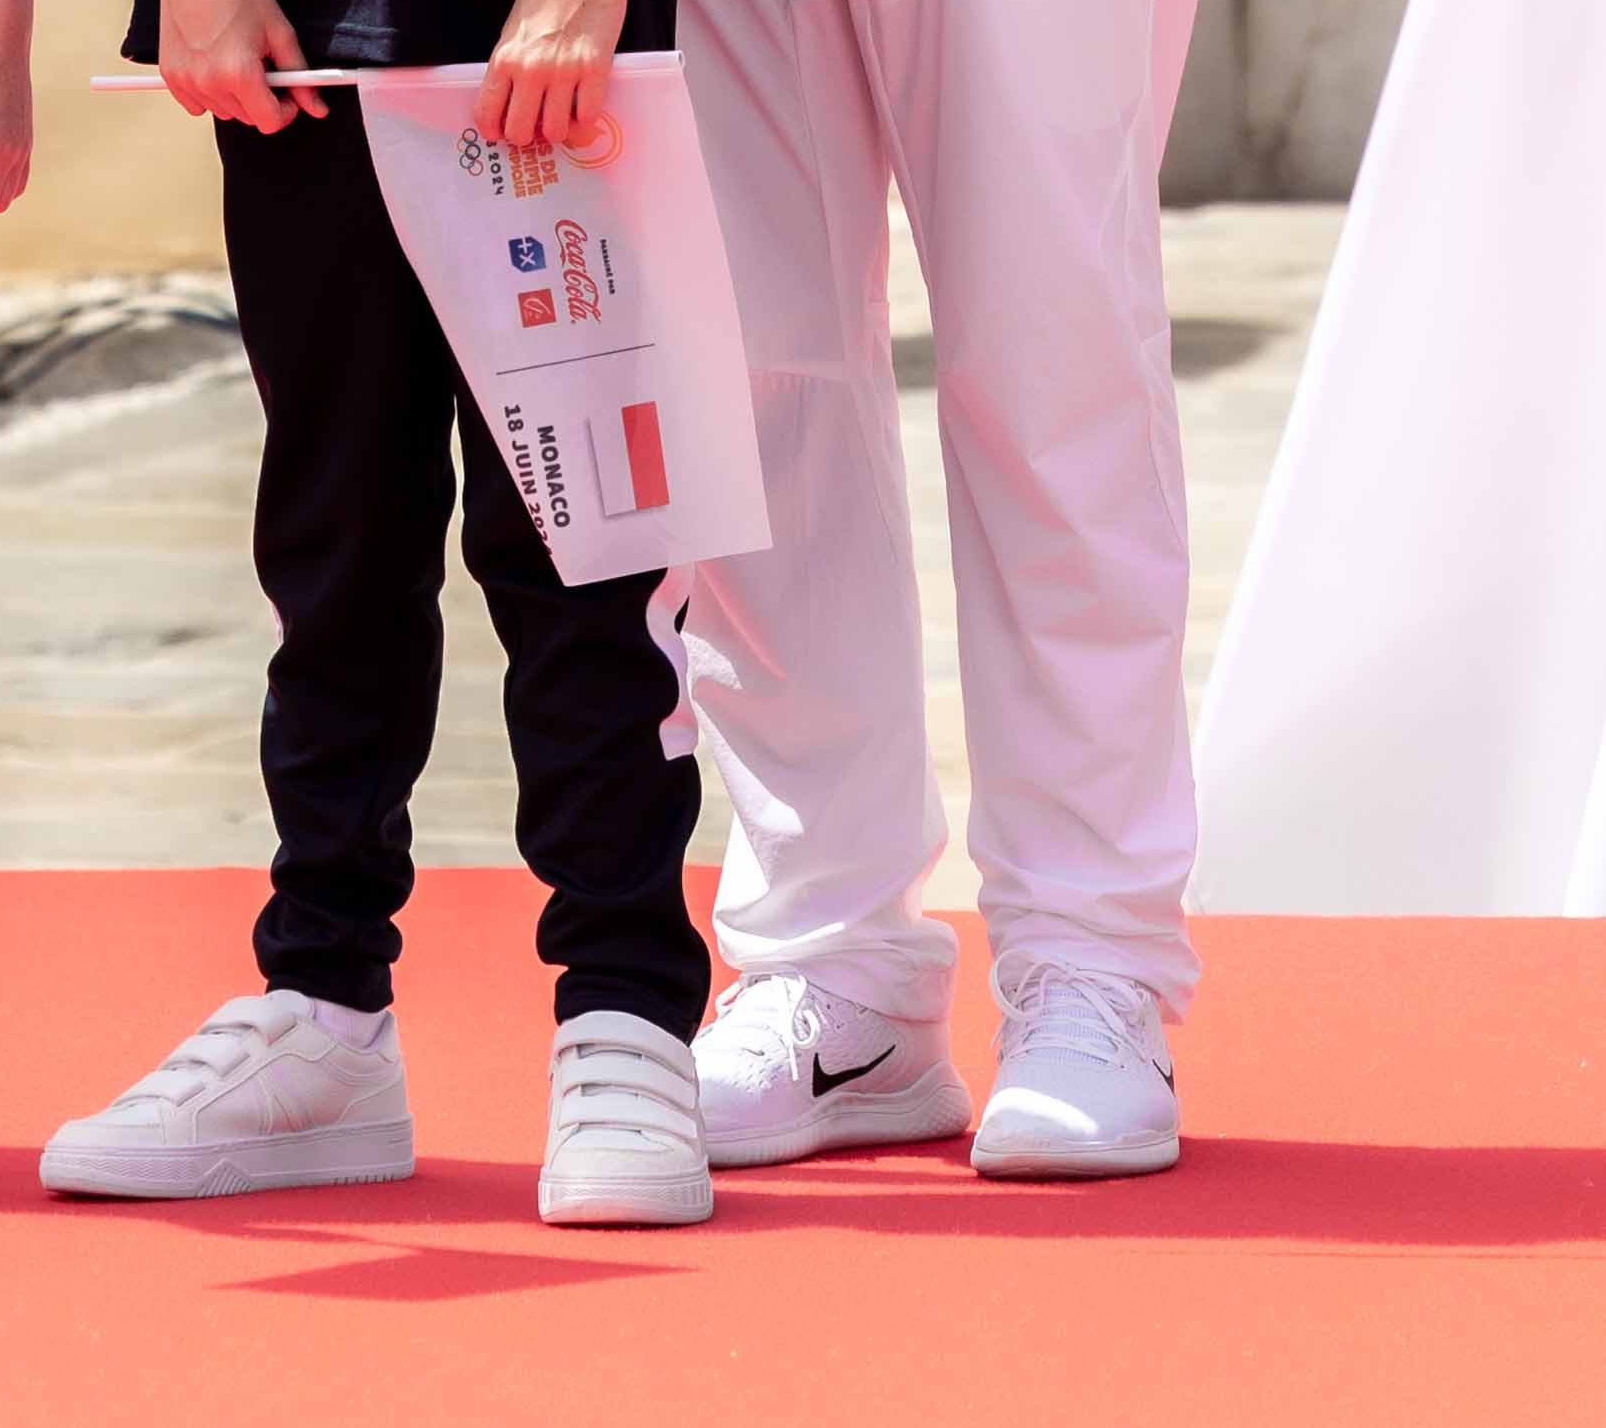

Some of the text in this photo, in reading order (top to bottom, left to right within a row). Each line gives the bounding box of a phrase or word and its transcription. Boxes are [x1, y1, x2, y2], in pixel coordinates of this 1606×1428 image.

[488, 152, 505, 195] 2024
[540, 159, 559, 185] DE
[554, 219, 602, 324] Coca-Cola
[504, 404, 524, 432] 18
[512, 440, 537, 495] JUIN
[537, 425, 570, 528] MONACO
